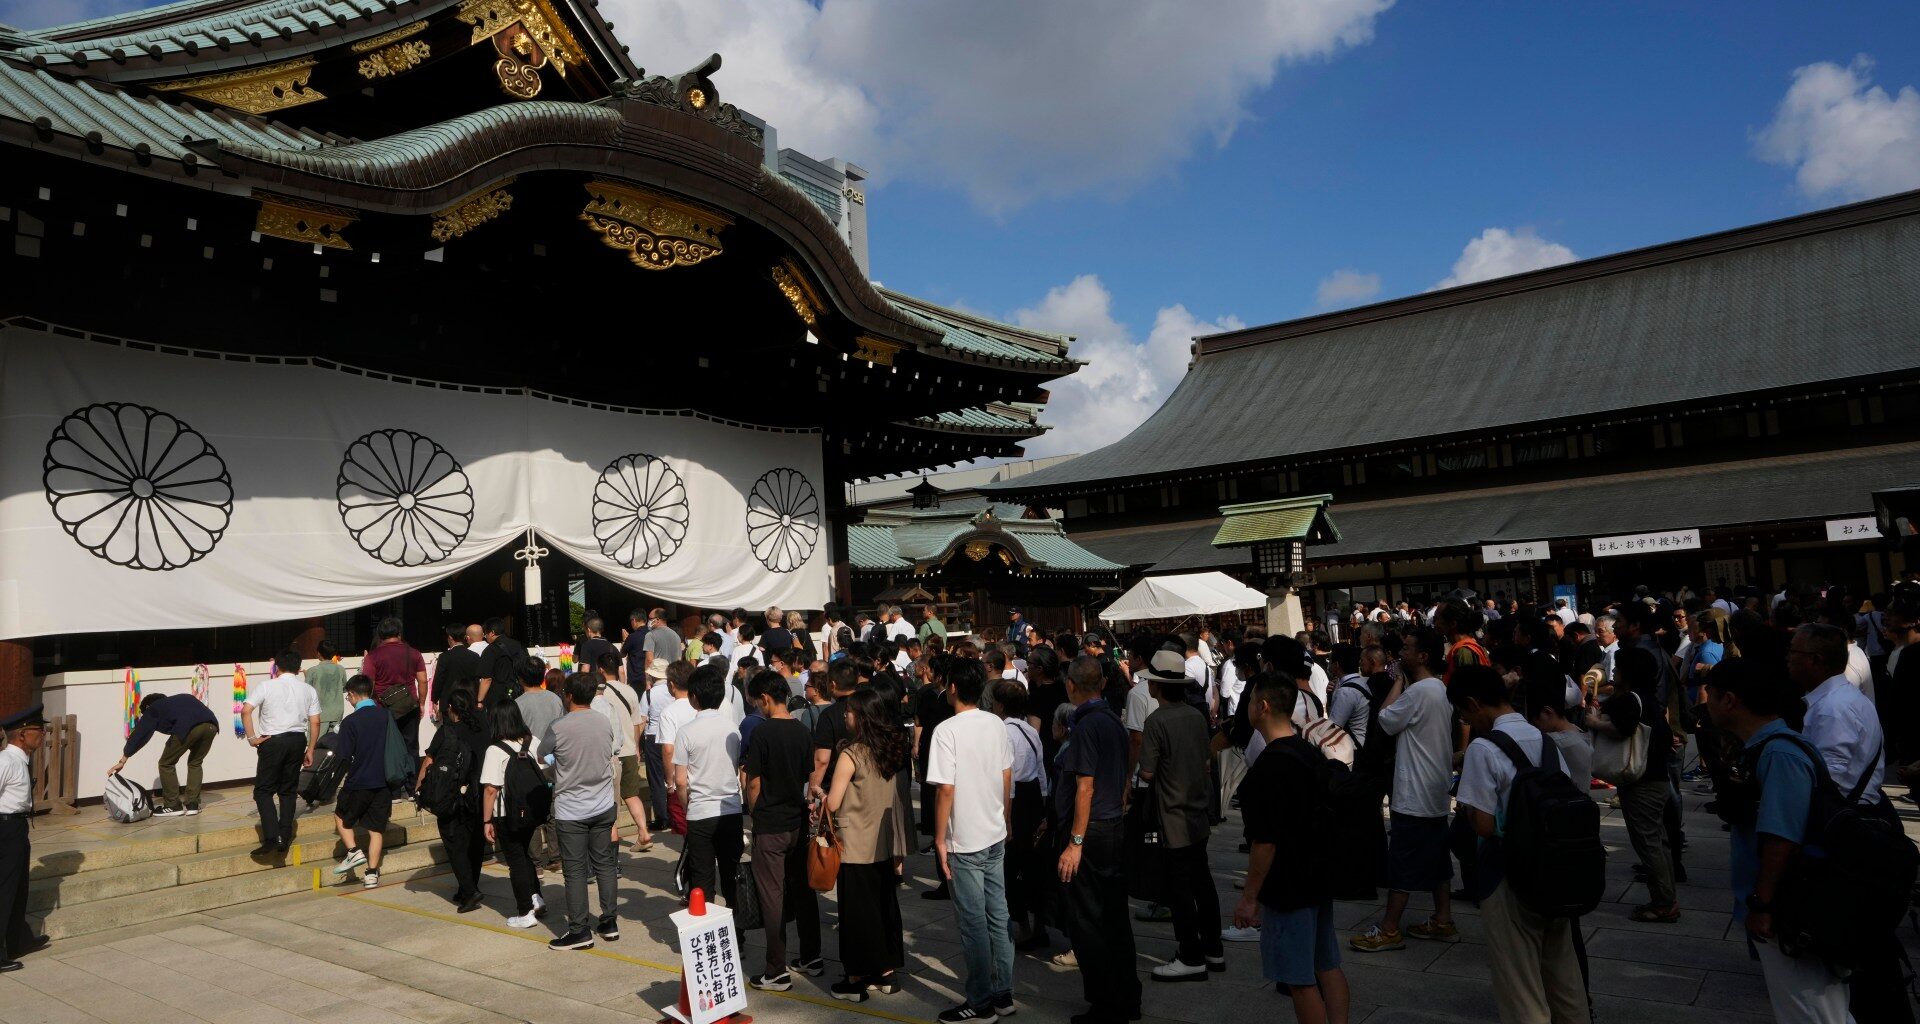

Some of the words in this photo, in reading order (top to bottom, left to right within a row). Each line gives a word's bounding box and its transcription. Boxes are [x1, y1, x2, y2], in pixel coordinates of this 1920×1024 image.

[1498, 547, 1534, 558] 朱印所
[1842, 523, 1877, 535] おみ
[690, 934, 709, 988] び下さい。
[704, 929, 726, 1006] 列後方にお並
[717, 925, 739, 999] 御参拝の方は
